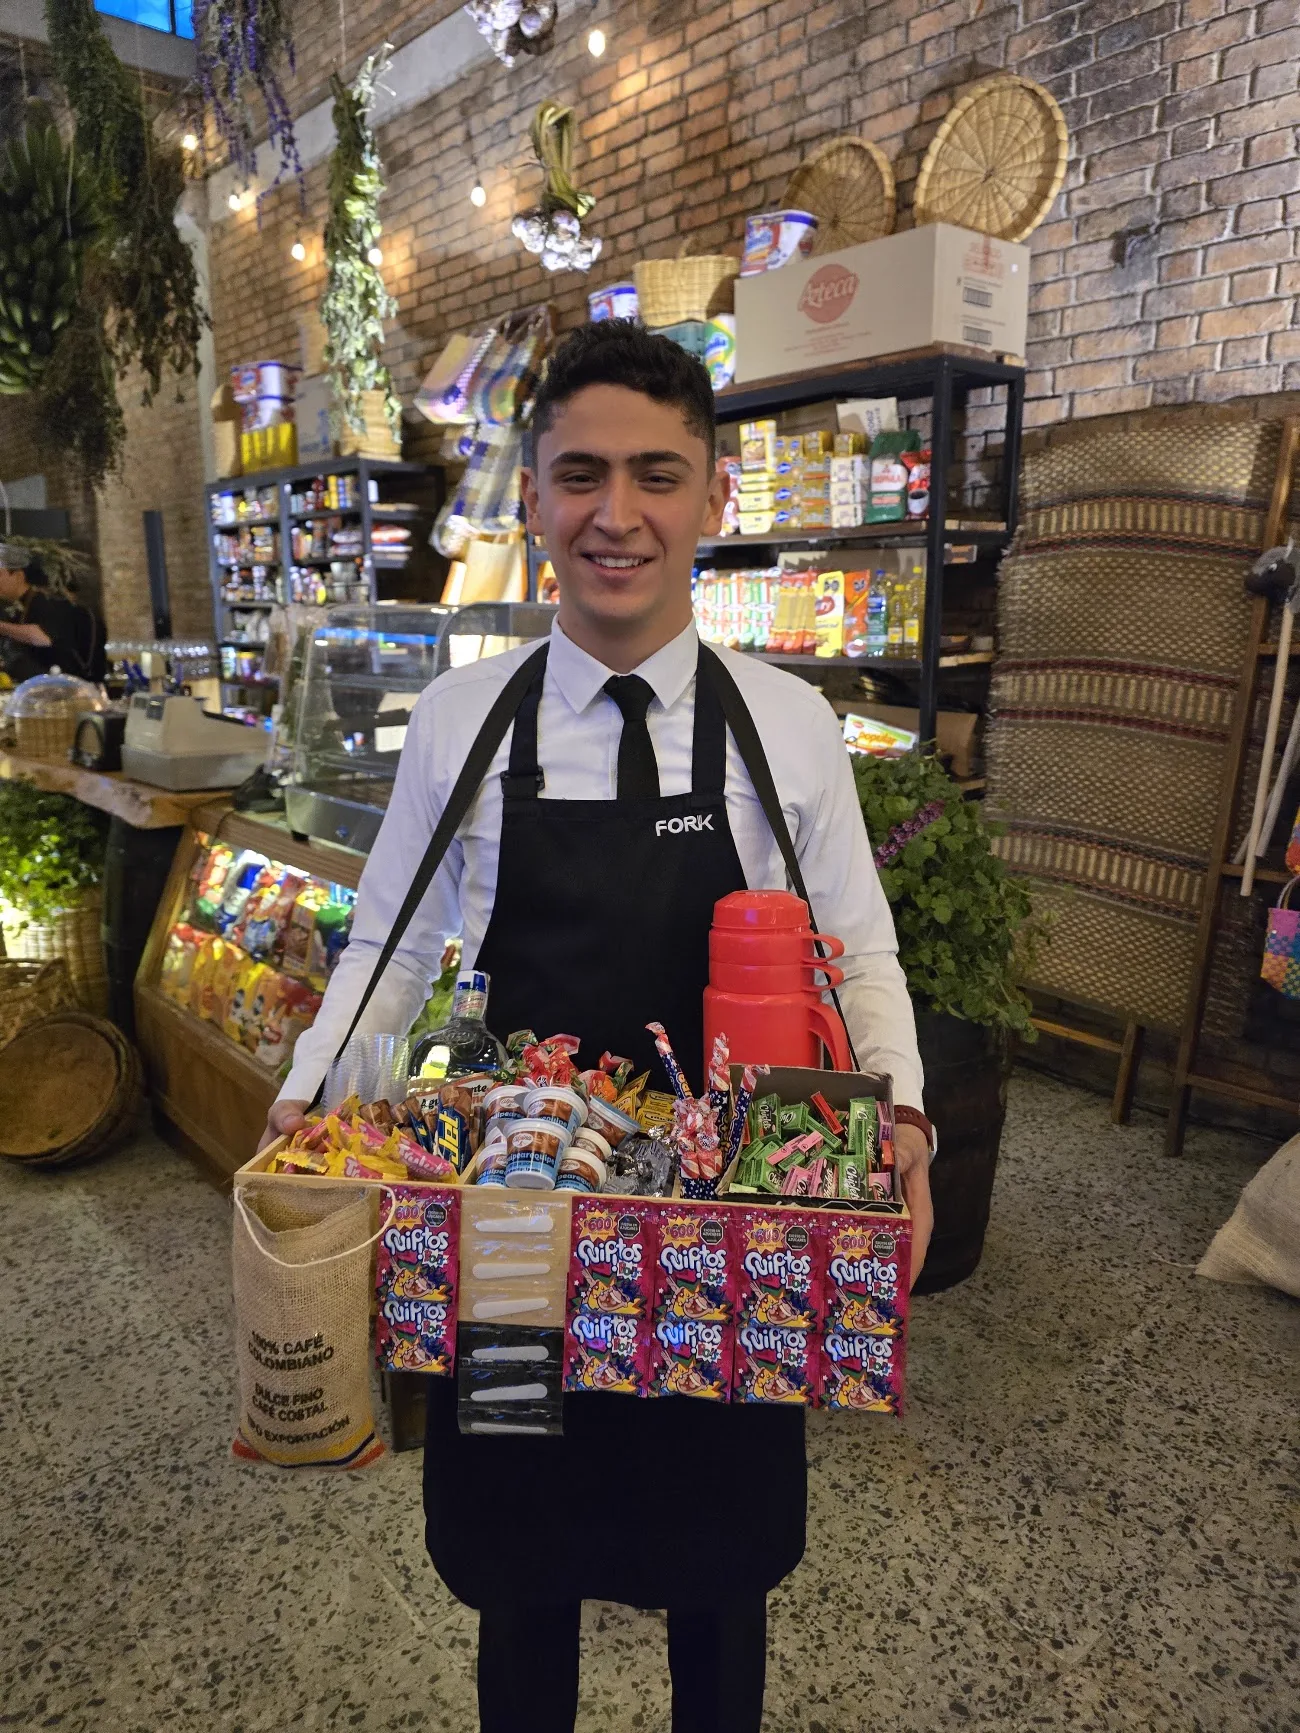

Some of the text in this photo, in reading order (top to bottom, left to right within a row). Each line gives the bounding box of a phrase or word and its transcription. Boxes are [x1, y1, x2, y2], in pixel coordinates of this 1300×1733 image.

[798, 272, 861, 312] Azteca
[655, 814, 715, 837] FORK
[248, 1339, 335, 1371] COLOMBIANO
[278, 1401, 328, 1422] COSTAL
